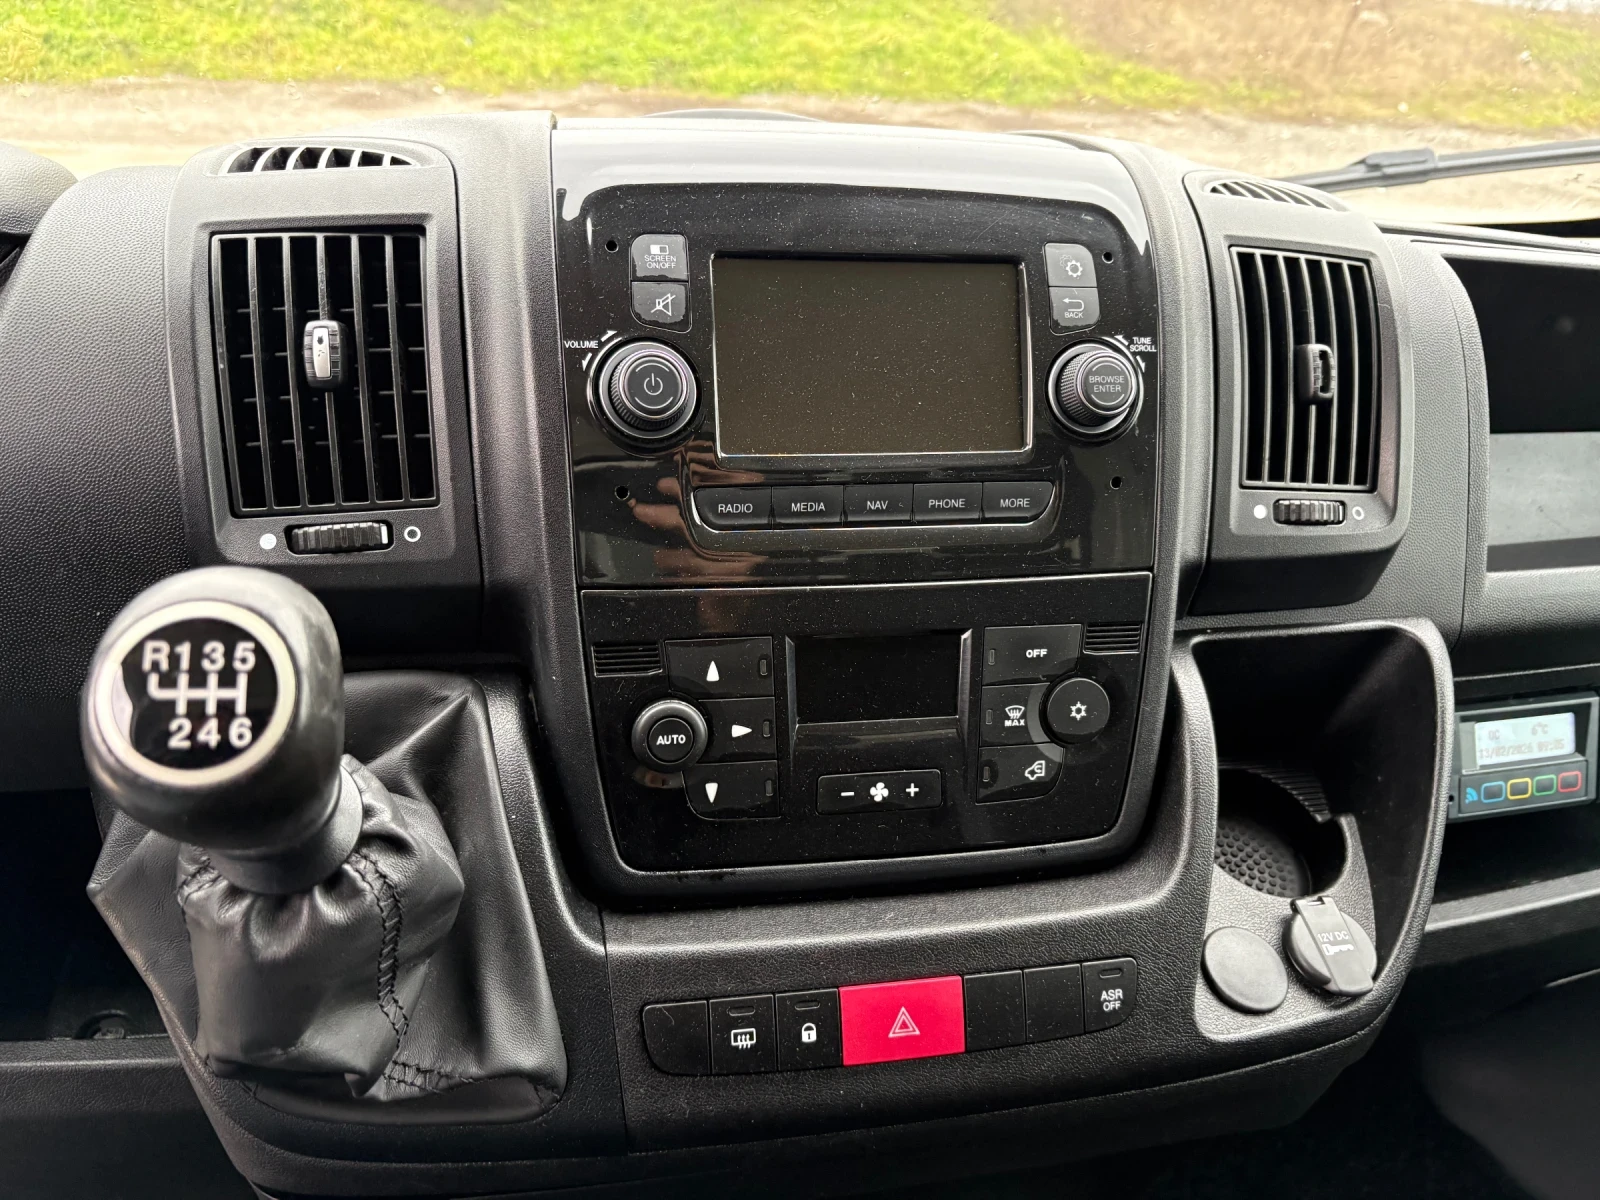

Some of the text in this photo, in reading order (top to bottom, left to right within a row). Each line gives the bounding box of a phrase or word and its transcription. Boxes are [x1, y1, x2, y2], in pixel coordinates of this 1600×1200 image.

[646, 261, 677, 269] ON/OFF
[564, 340, 599, 349] VOLUME
[1132, 337, 1152, 345] TUNE
[1129, 344, 1157, 353] SCROLL
[1088, 375, 1125, 384] BROWSE
[1093, 384, 1122, 393] ENTER
[791, 502, 826, 512] MEDIA
[866, 500, 889, 510] NAV
[928, 499, 966, 509] PHONE
[1000, 498, 1031, 508] MORE
[717, 503, 754, 514] RADIO
[1025, 649, 1048, 658] OFF
[1004, 719, 1026, 727] MAX
[656, 734, 686, 745] AUTO
[1317, 930, 1349, 943] 12V DC
[1101, 988, 1123, 1001] ASR
[1103, 1001, 1121, 1012] OFF
